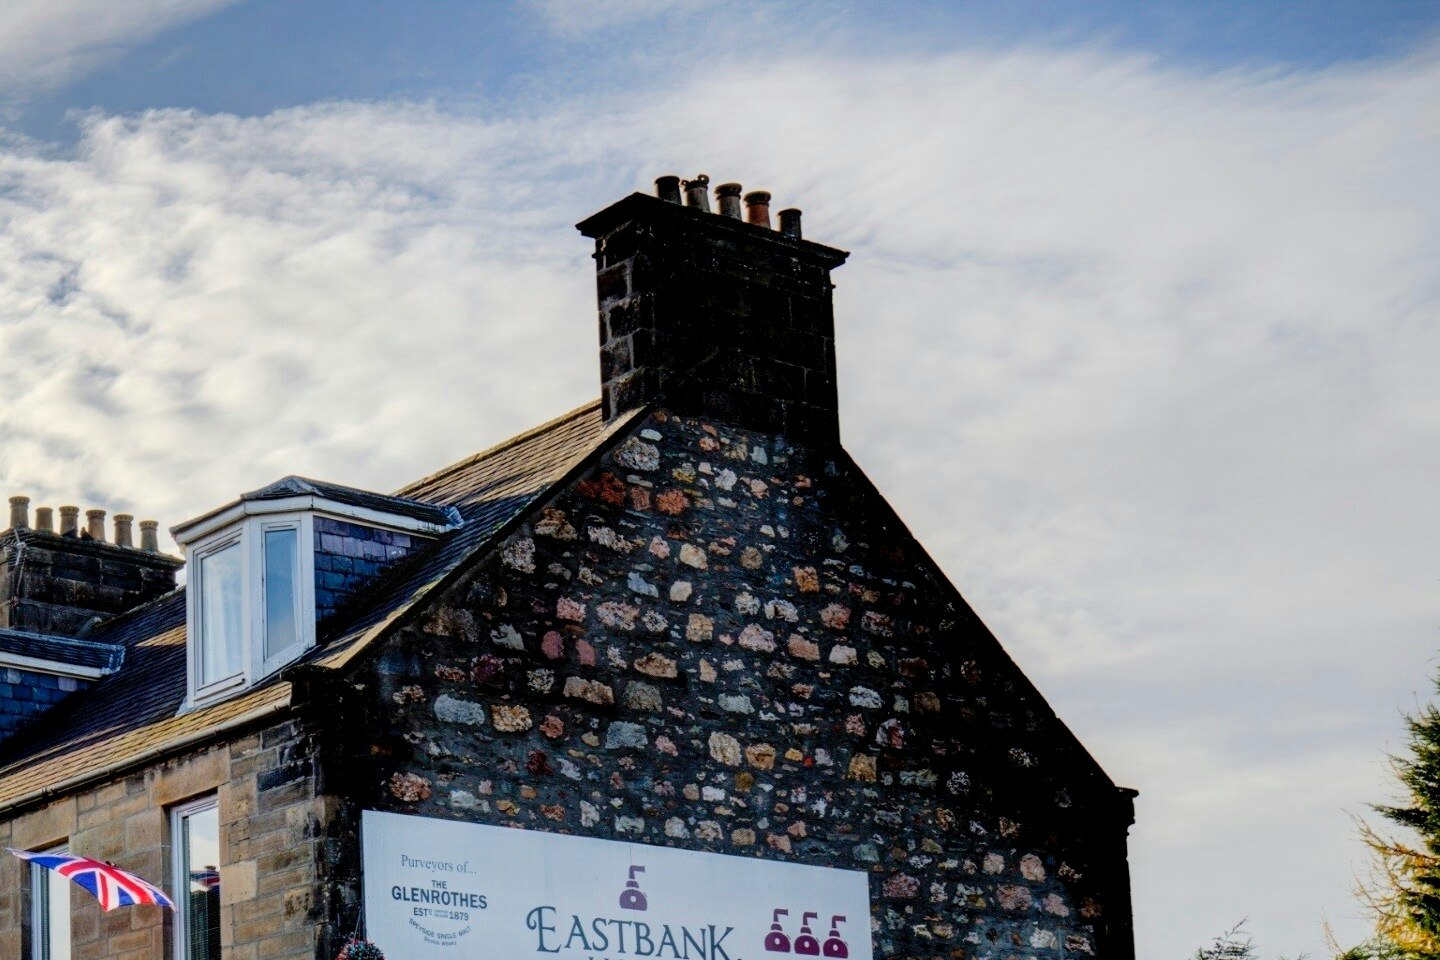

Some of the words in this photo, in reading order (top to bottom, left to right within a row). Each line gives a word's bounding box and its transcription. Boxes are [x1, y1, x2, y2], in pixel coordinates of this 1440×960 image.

[401, 854, 454, 873] Purveyors
[431, 880, 447, 889] THE
[391, 885, 488, 909] GLENROTHES
[449, 911, 469, 921] 1879
[437, 932, 456, 940] SINGLE
[458, 926, 471, 937] MALT
